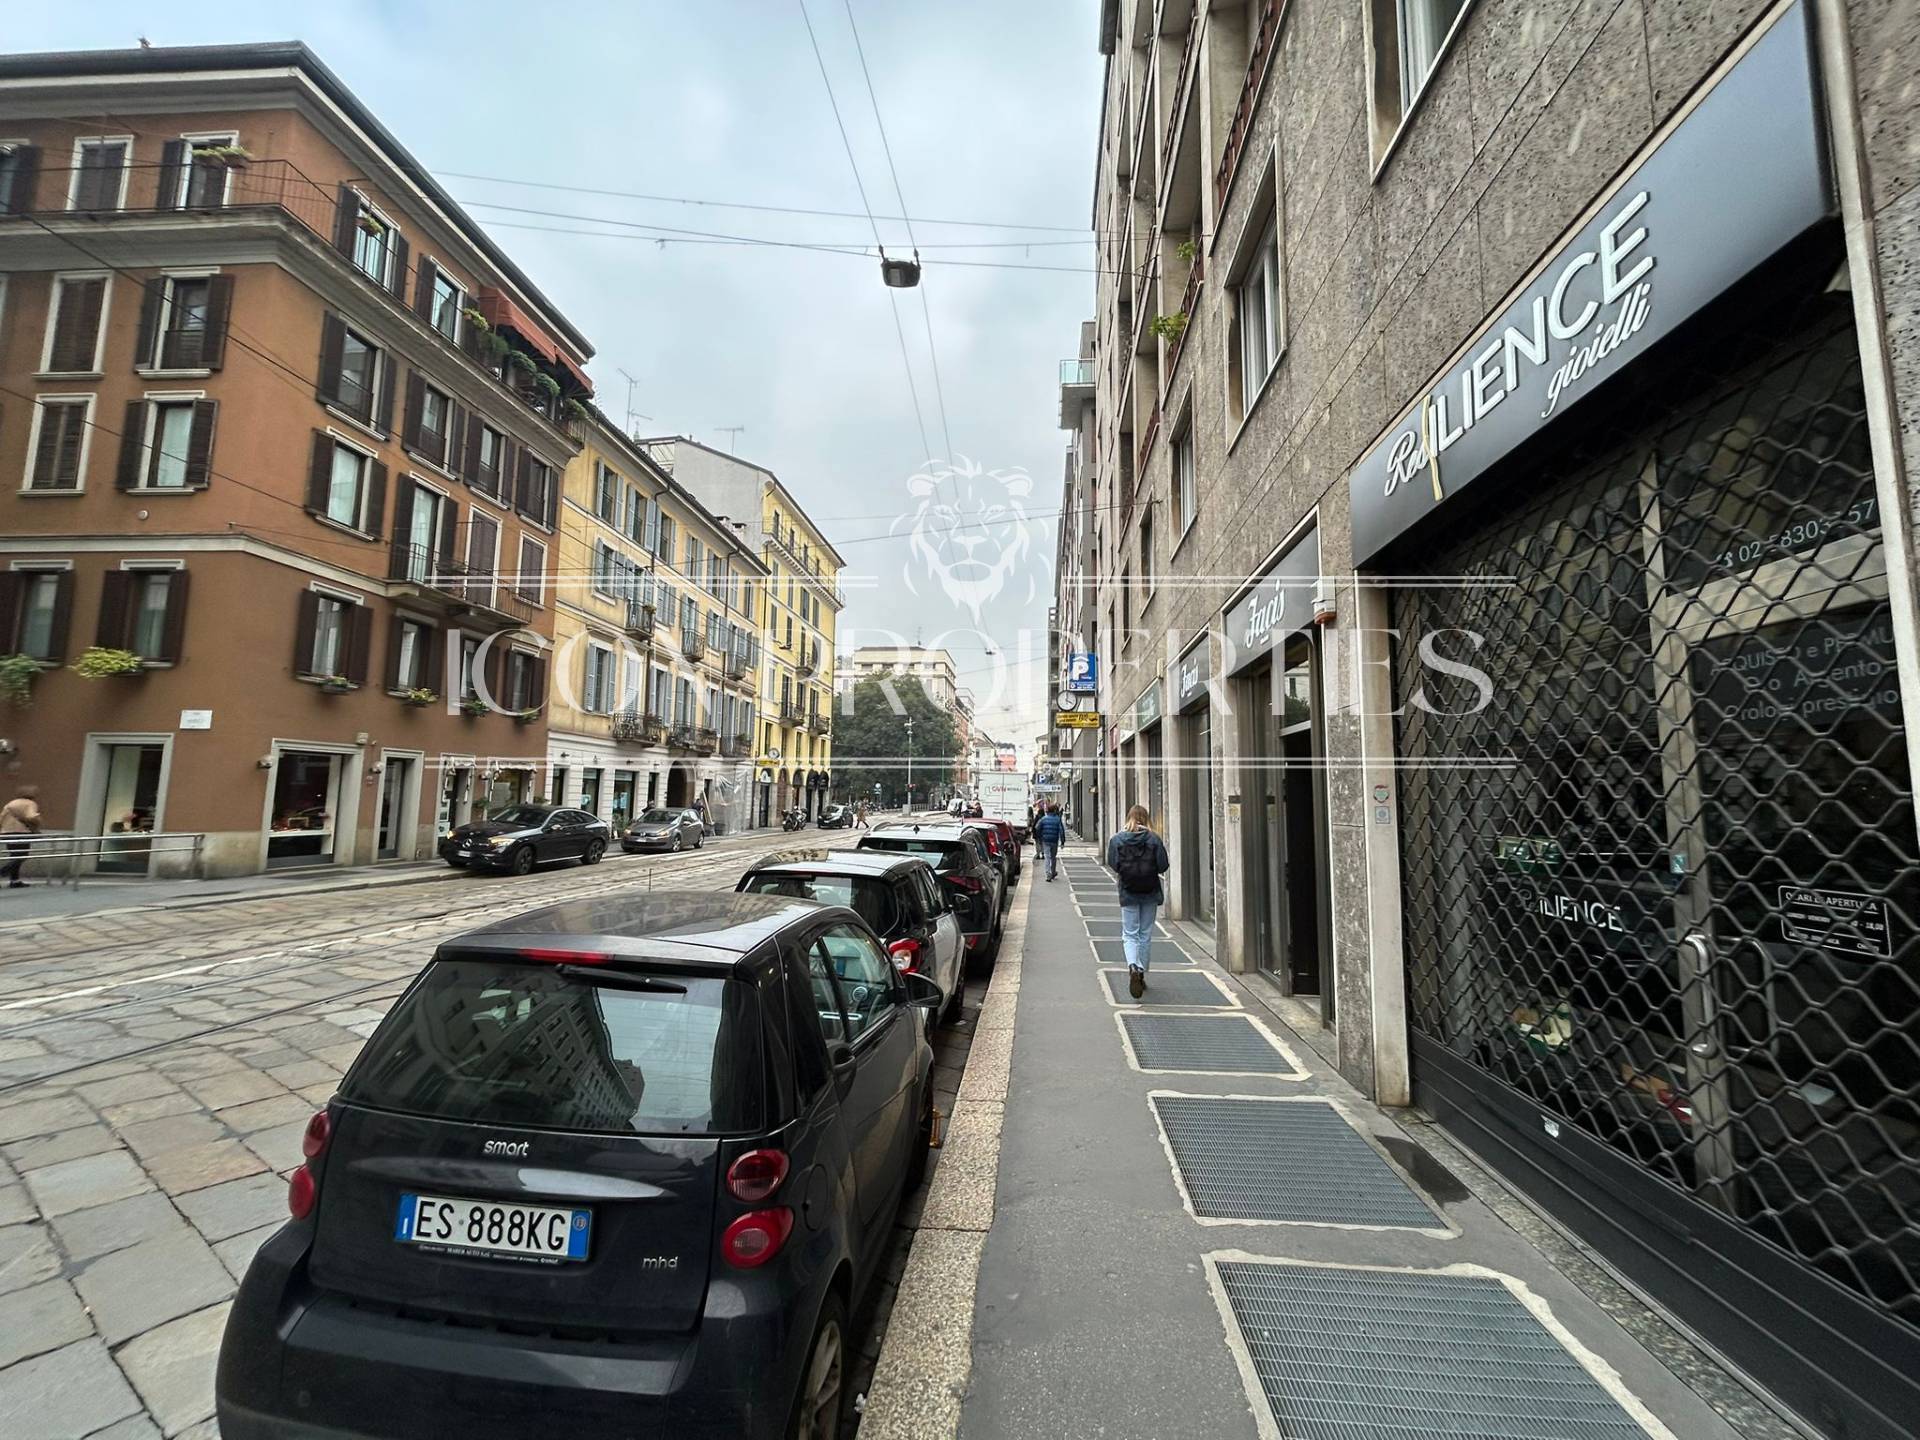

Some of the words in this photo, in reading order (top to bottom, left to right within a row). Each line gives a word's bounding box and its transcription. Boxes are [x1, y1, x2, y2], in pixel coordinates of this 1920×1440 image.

[1541, 283, 1651, 418] gioielli
[1769, 498, 1876, 550] 5830357
[1072, 661, 1090, 681] P
[1785, 891, 1813, 903] OARI
[1825, 896, 1878, 911] APERTUA
[483, 1139, 530, 1157] smart
[416, 1201, 455, 1240] ES
[467, 1205, 566, 1251] 888KG
[642, 1255, 679, 1270] mhd
